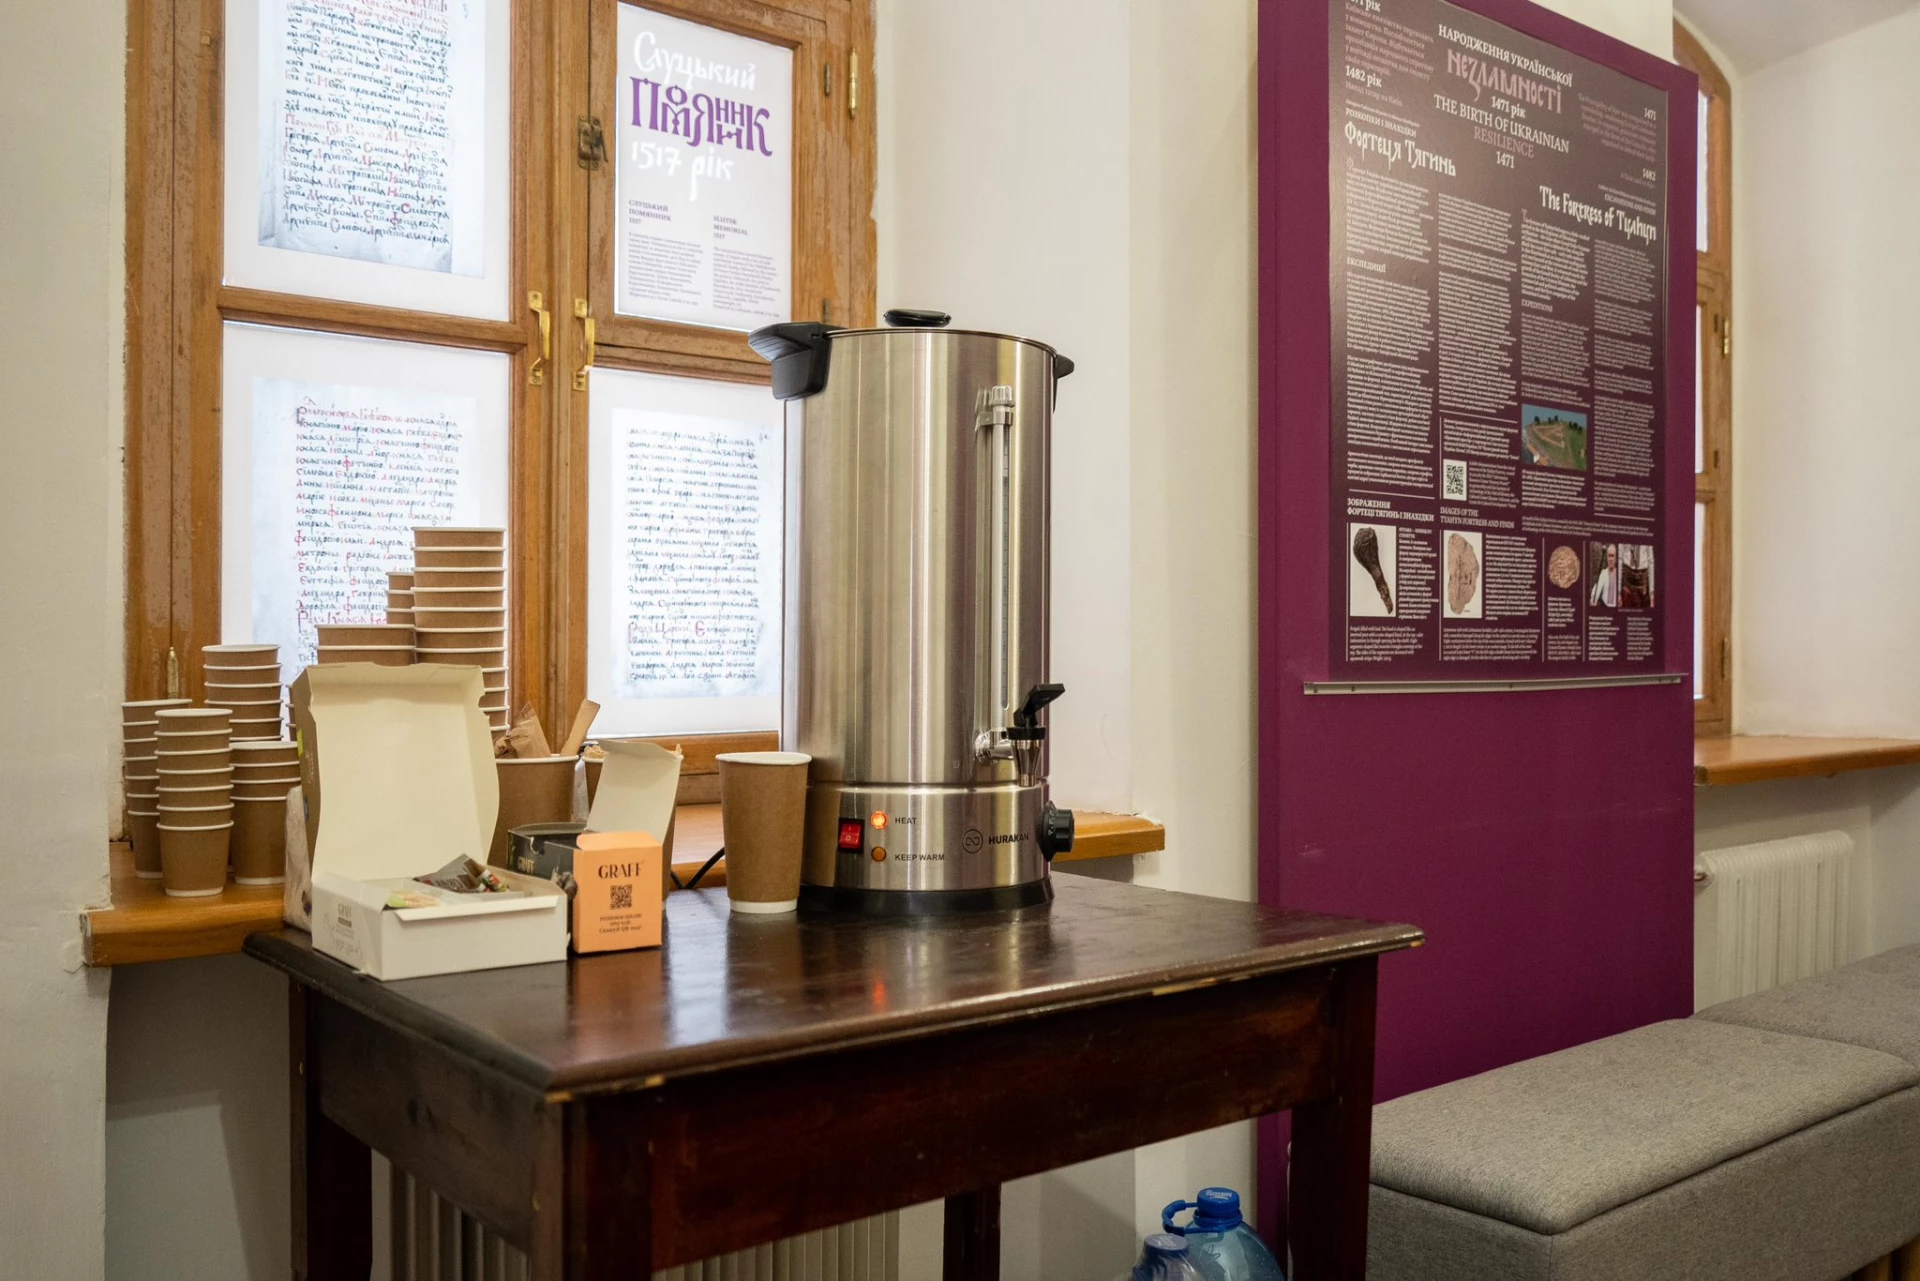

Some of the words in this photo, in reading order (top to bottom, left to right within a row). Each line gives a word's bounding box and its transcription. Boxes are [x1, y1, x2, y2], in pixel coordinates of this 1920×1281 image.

[633, 31, 756, 92] Слуцький
[1438, 24, 1510, 63] НАРОДЖЕННЯ
[1511, 53, 1574, 87] УКРАЇНСЬКОЇ
[1345, 65, 1366, 82] 1482
[1366, 73, 1382, 88] рік
[1491, 95, 1509, 112] 1471
[1510, 103, 1526, 119] рік
[1434, 94, 1458, 115] THE
[1459, 101, 1493, 128] BIRTH
[1494, 116, 1509, 132] OF
[1510, 122, 1570, 154] UKRAINIAN
[1344, 121, 1402, 171] Фортеця
[1404, 140, 1457, 177] Тягинь
[1474, 126, 1535, 158] RESILIENCE
[630, 141, 682, 176] 1517
[689, 147, 735, 203] рік
[1496, 151, 1515, 169] 1471
[1539, 185, 1561, 211] The
[1604, 207, 1615, 228] of
[895, 817, 917, 825] HEAT
[988, 832, 1030, 845] HURAKAN
[895, 853, 918, 861] KEEP
[919, 853, 945, 861] WARM
